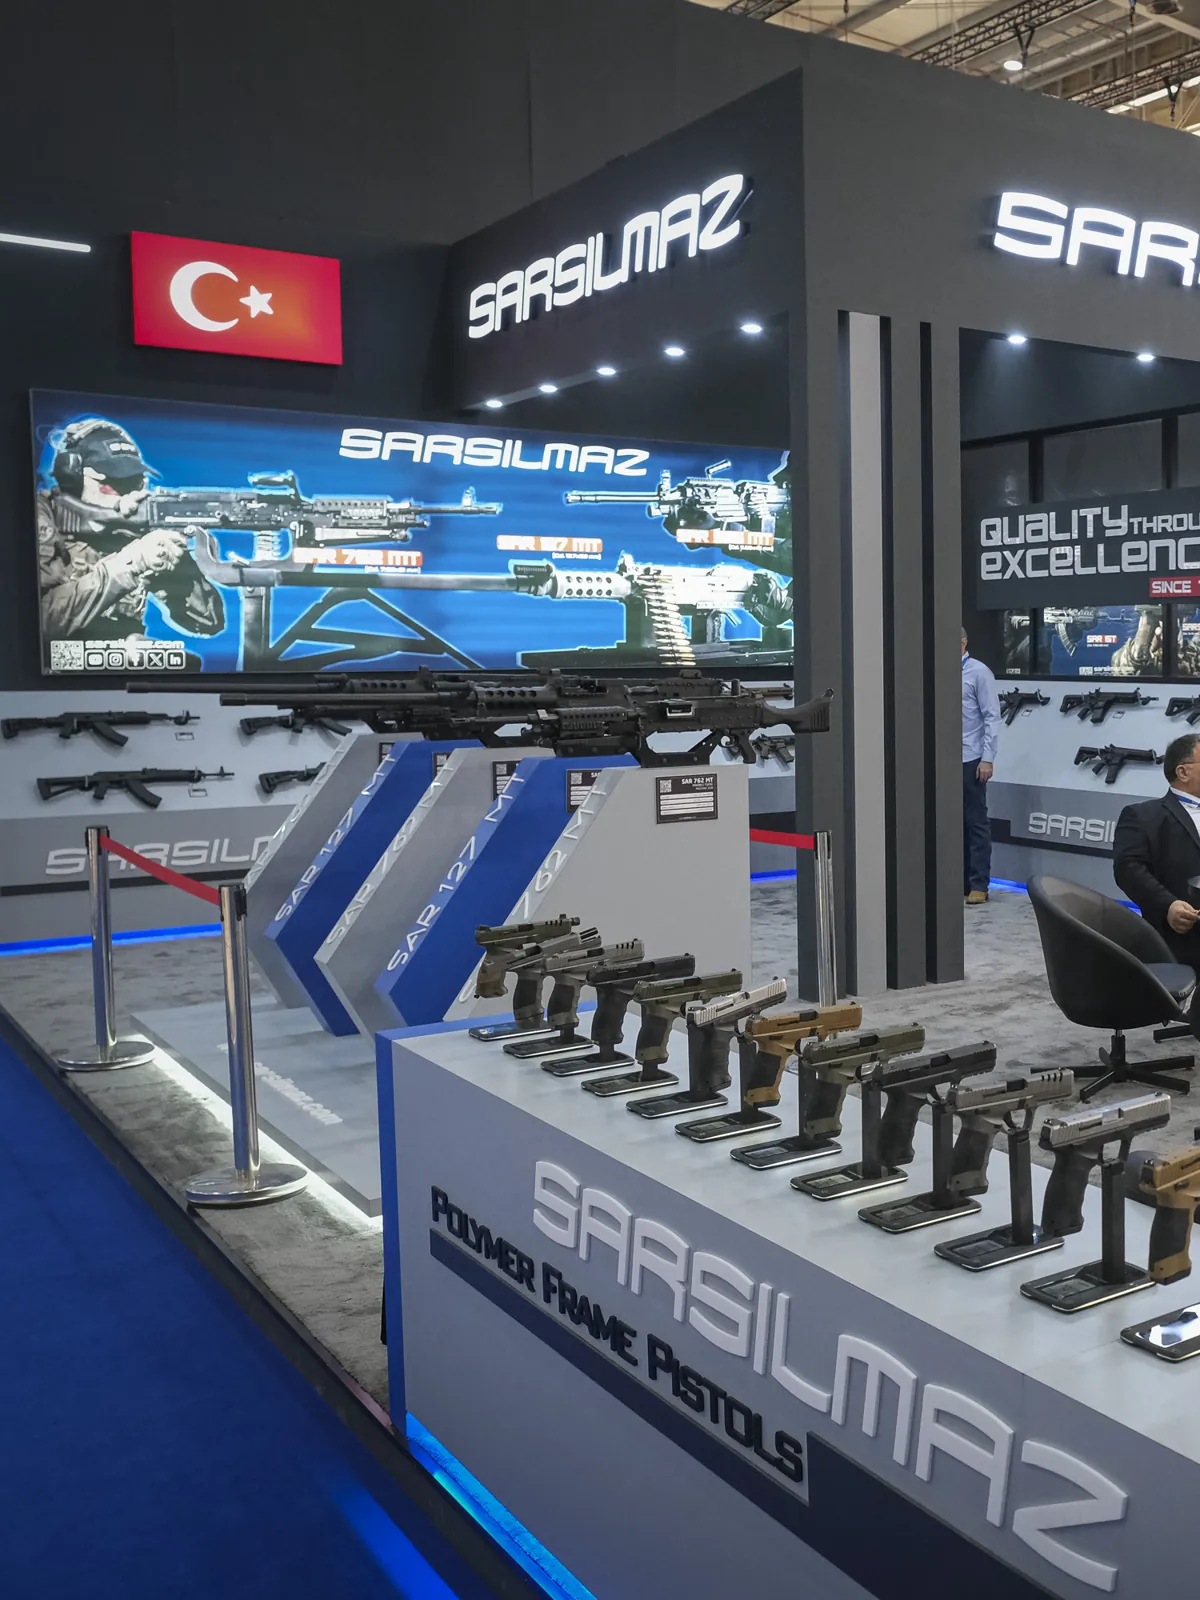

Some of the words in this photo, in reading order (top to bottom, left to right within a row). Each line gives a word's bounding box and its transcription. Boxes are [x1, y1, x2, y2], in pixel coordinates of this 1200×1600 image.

[468, 174, 745, 338] SARSILMAZ
[338, 427, 650, 477] SARSILMAZ
[1151, 579, 1192, 594] SINCE
[274, 864, 321, 921] SAR
[319, 807, 354, 857] 127
[361, 753, 396, 796] MT
[326, 882, 375, 945] SAR
[419, 761, 454, 808] MT
[386, 903, 441, 971] SAR
[438, 835, 476, 893] 127
[484, 772, 525, 823] MT
[511, 849, 568, 920] 762
[563, 784, 607, 841] MT
[431, 1185, 536, 1290] POLYMER
[542, 1265, 638, 1368] FRAME
[647, 1334, 803, 1483] PISTOLS
[532, 1160, 1128, 1592] SARSILMAZ
